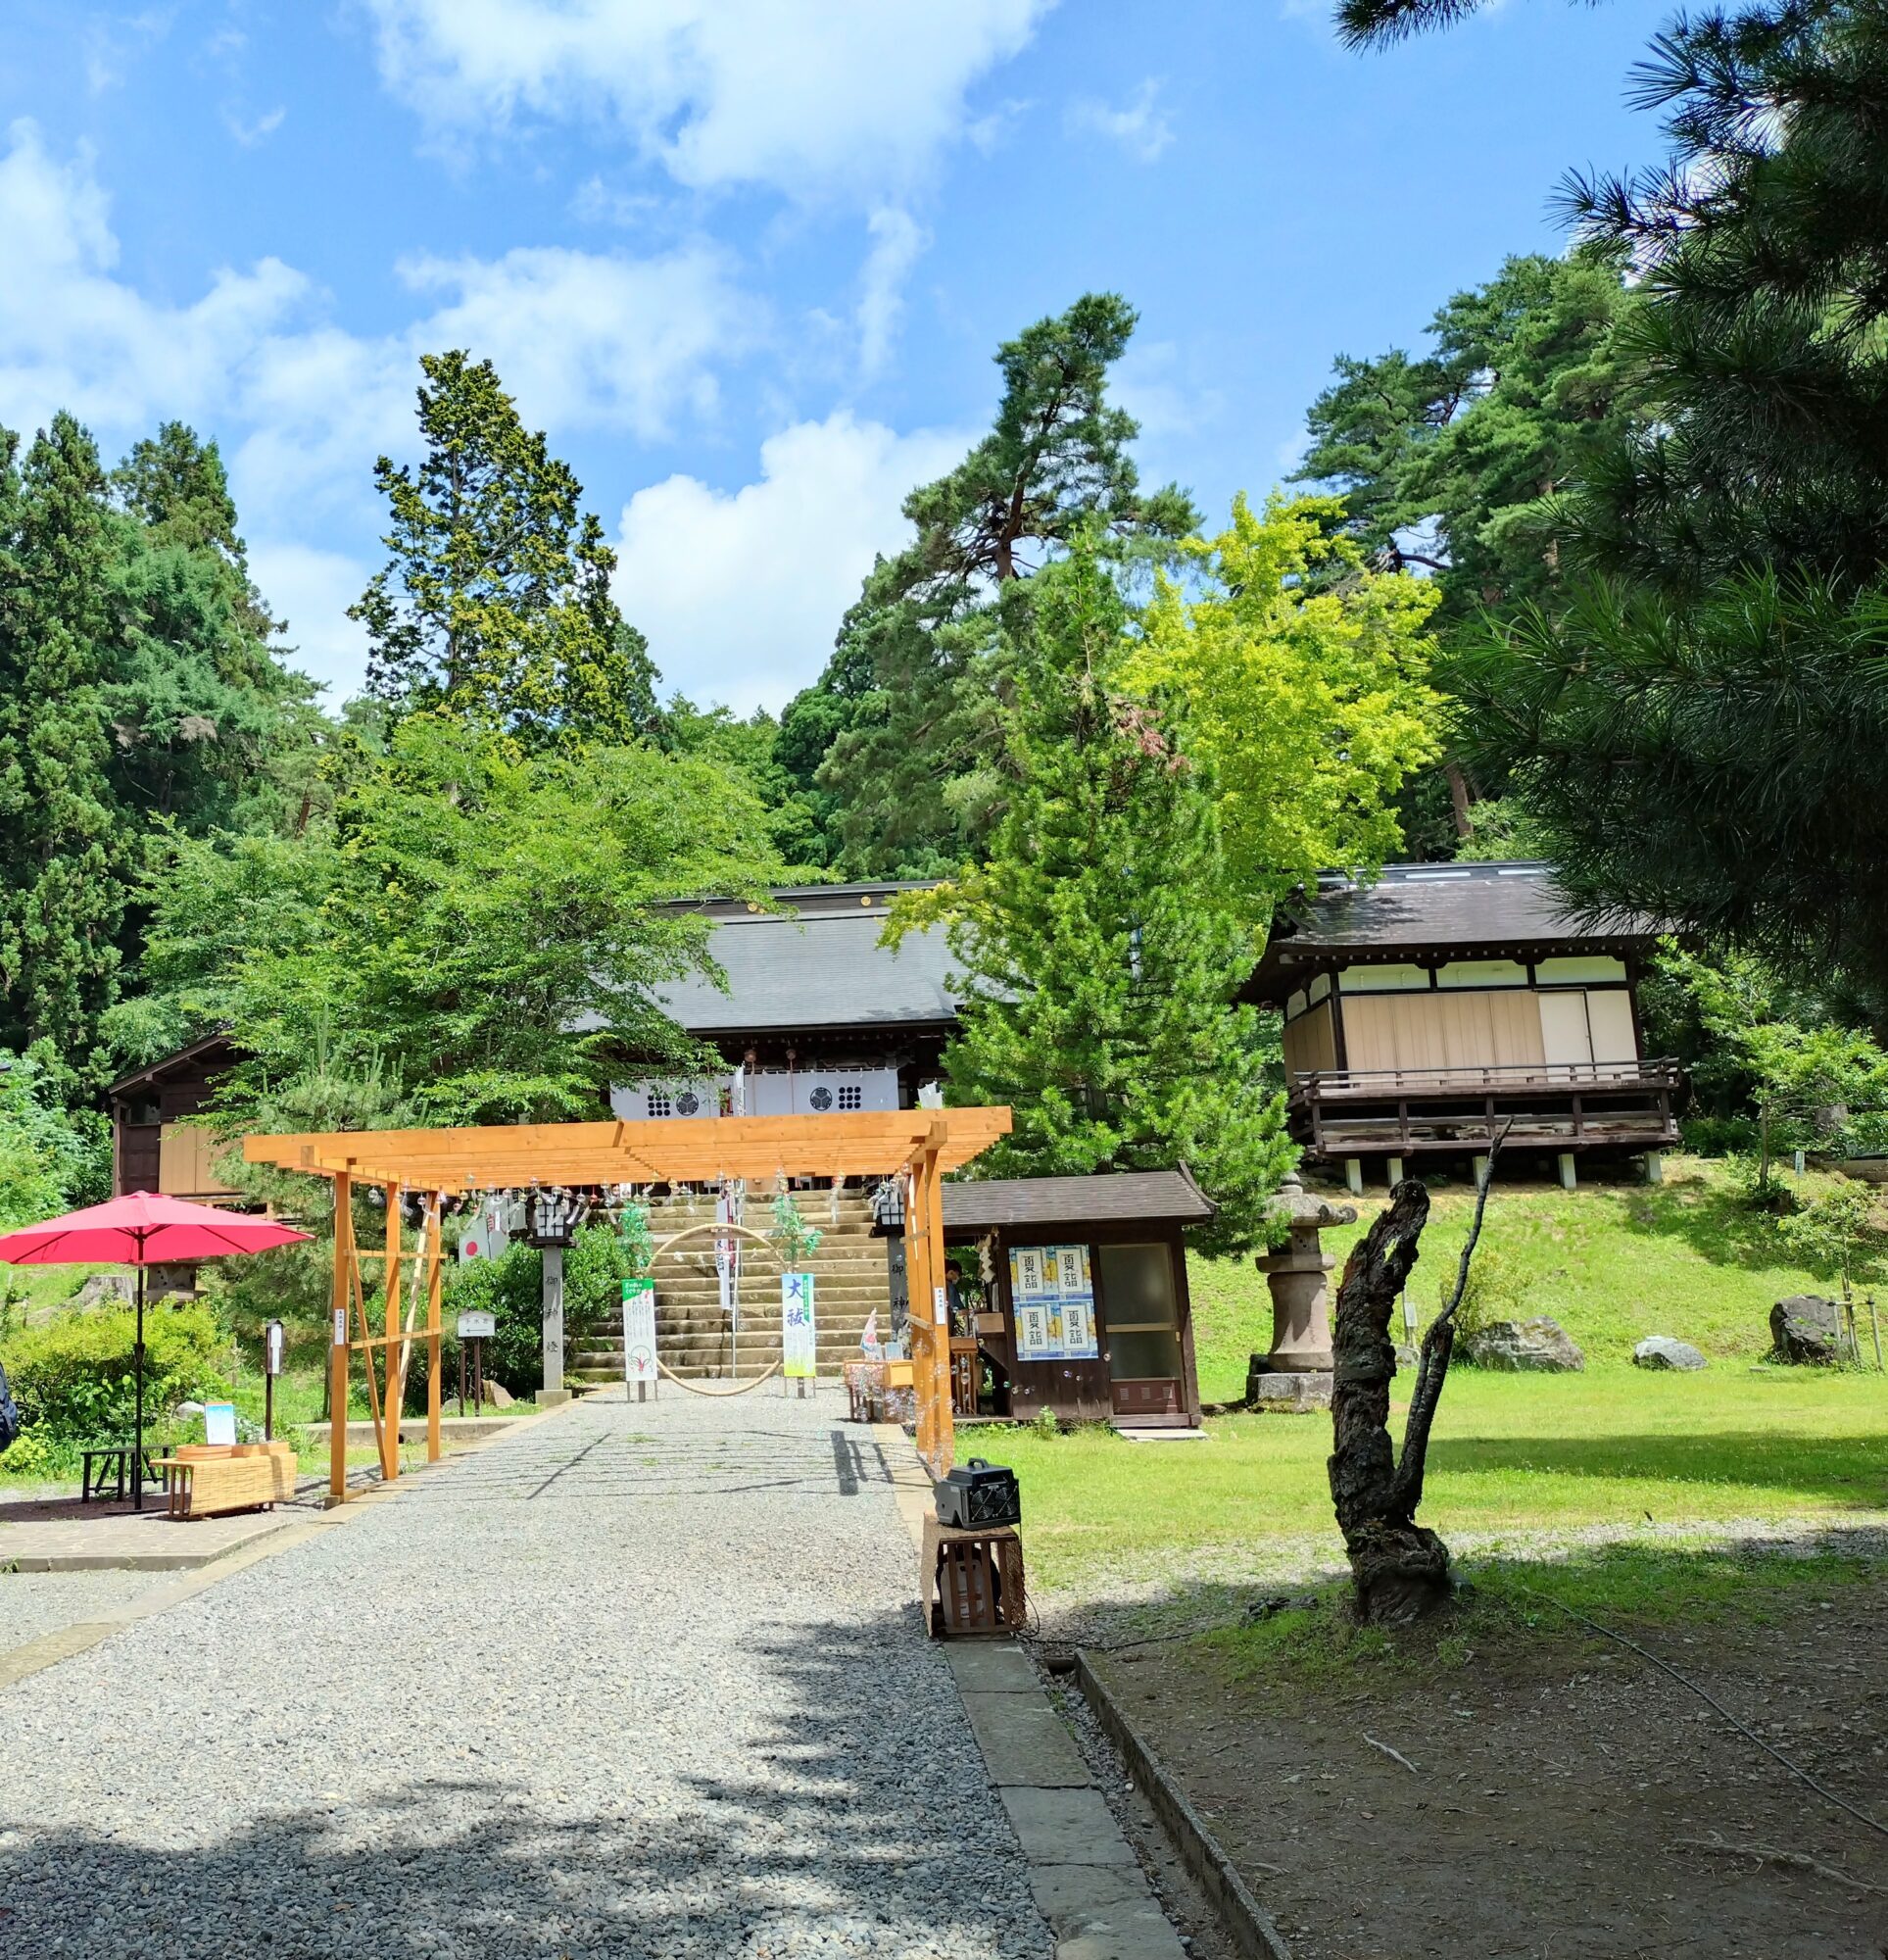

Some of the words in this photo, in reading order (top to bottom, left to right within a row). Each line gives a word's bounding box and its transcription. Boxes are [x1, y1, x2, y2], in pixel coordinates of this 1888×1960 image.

[1024, 1255, 1038, 1289] 夏詣
[1063, 1254, 1077, 1287] 夏詣
[787, 1278, 805, 1327] 大祓
[1028, 1311, 1042, 1345] 夏詣
[1068, 1310, 1083, 1344] 夏詣
